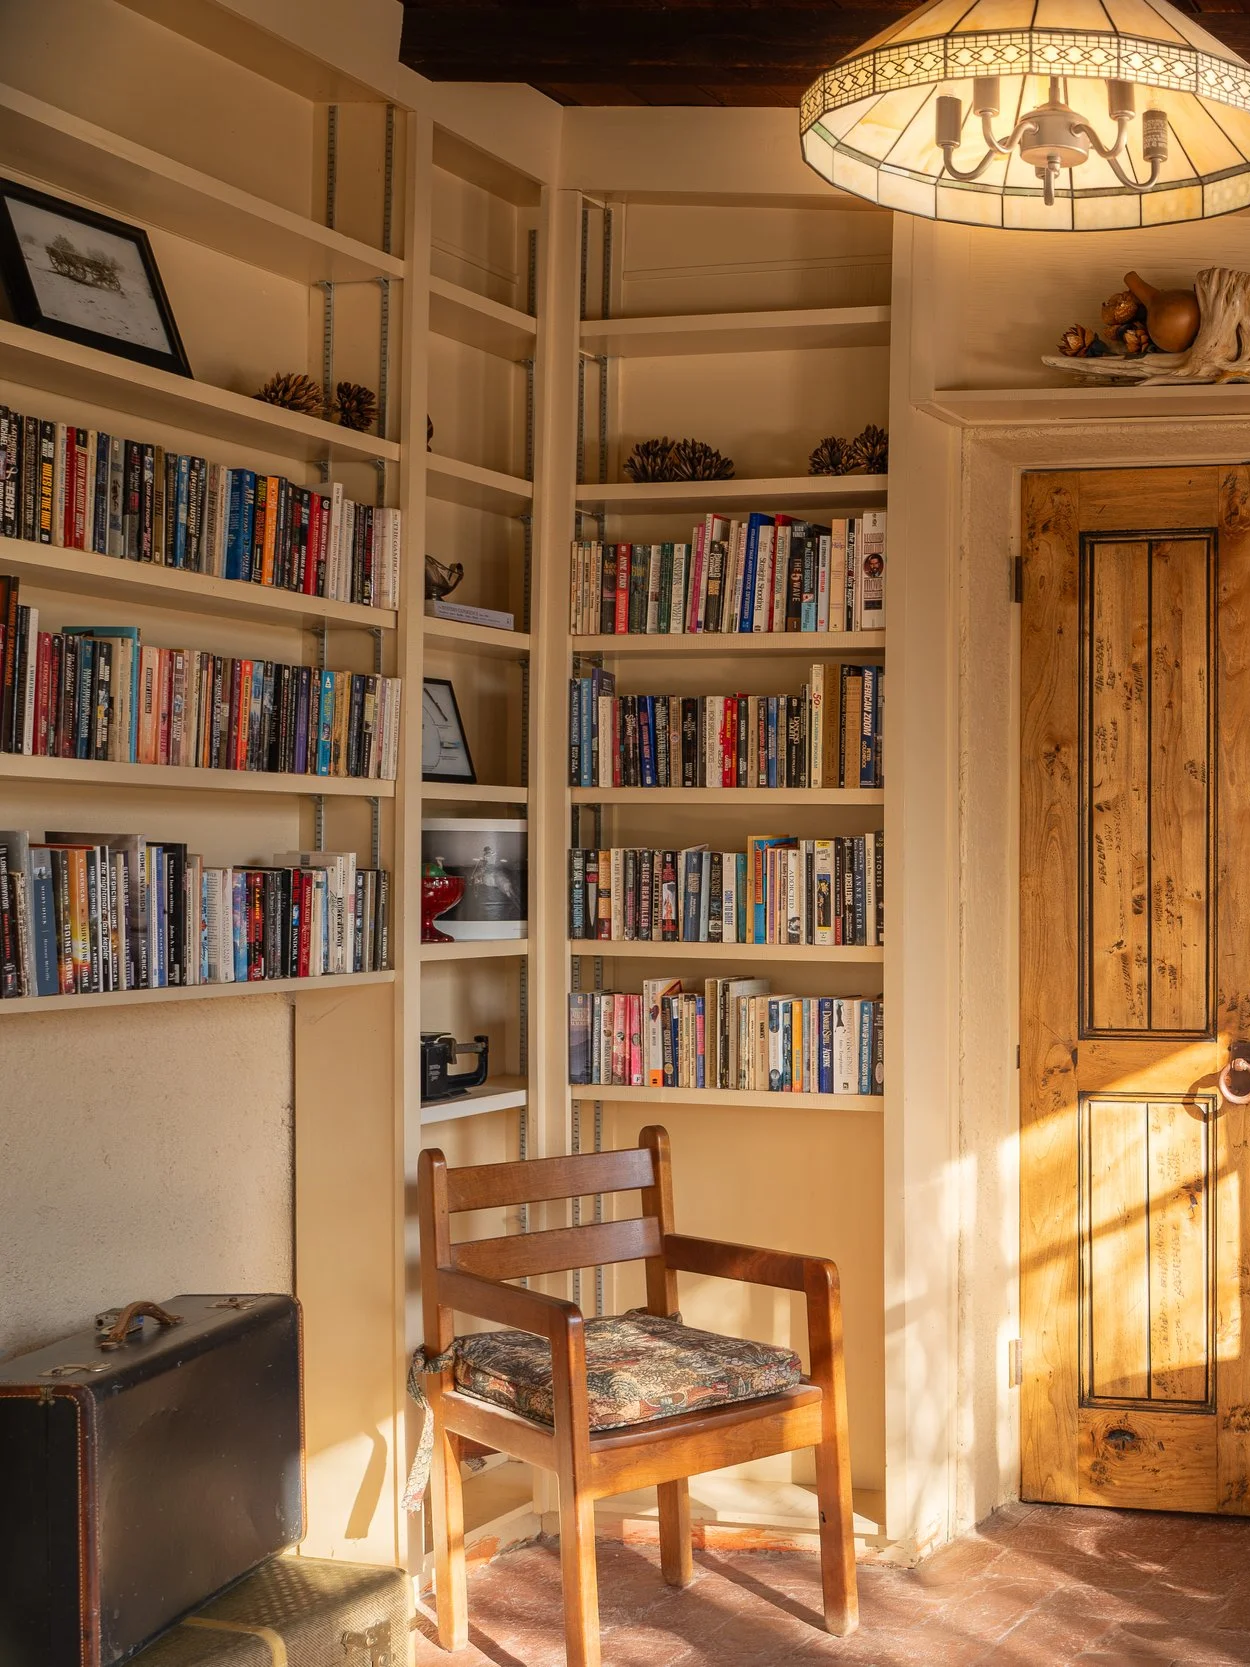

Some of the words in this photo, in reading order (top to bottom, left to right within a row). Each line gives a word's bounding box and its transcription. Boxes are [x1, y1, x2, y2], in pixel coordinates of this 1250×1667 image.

[43, 463, 52, 485] RULES
[42, 486, 51, 495] OF
[758, 557, 766, 581] Straight
[756, 583, 765, 611] Shooting
[793, 582, 801, 601] WAVE
[864, 670, 872, 712] AMERICAN
[863, 713, 871, 736] ZOOM
[0, 857, 8, 874] LONE
